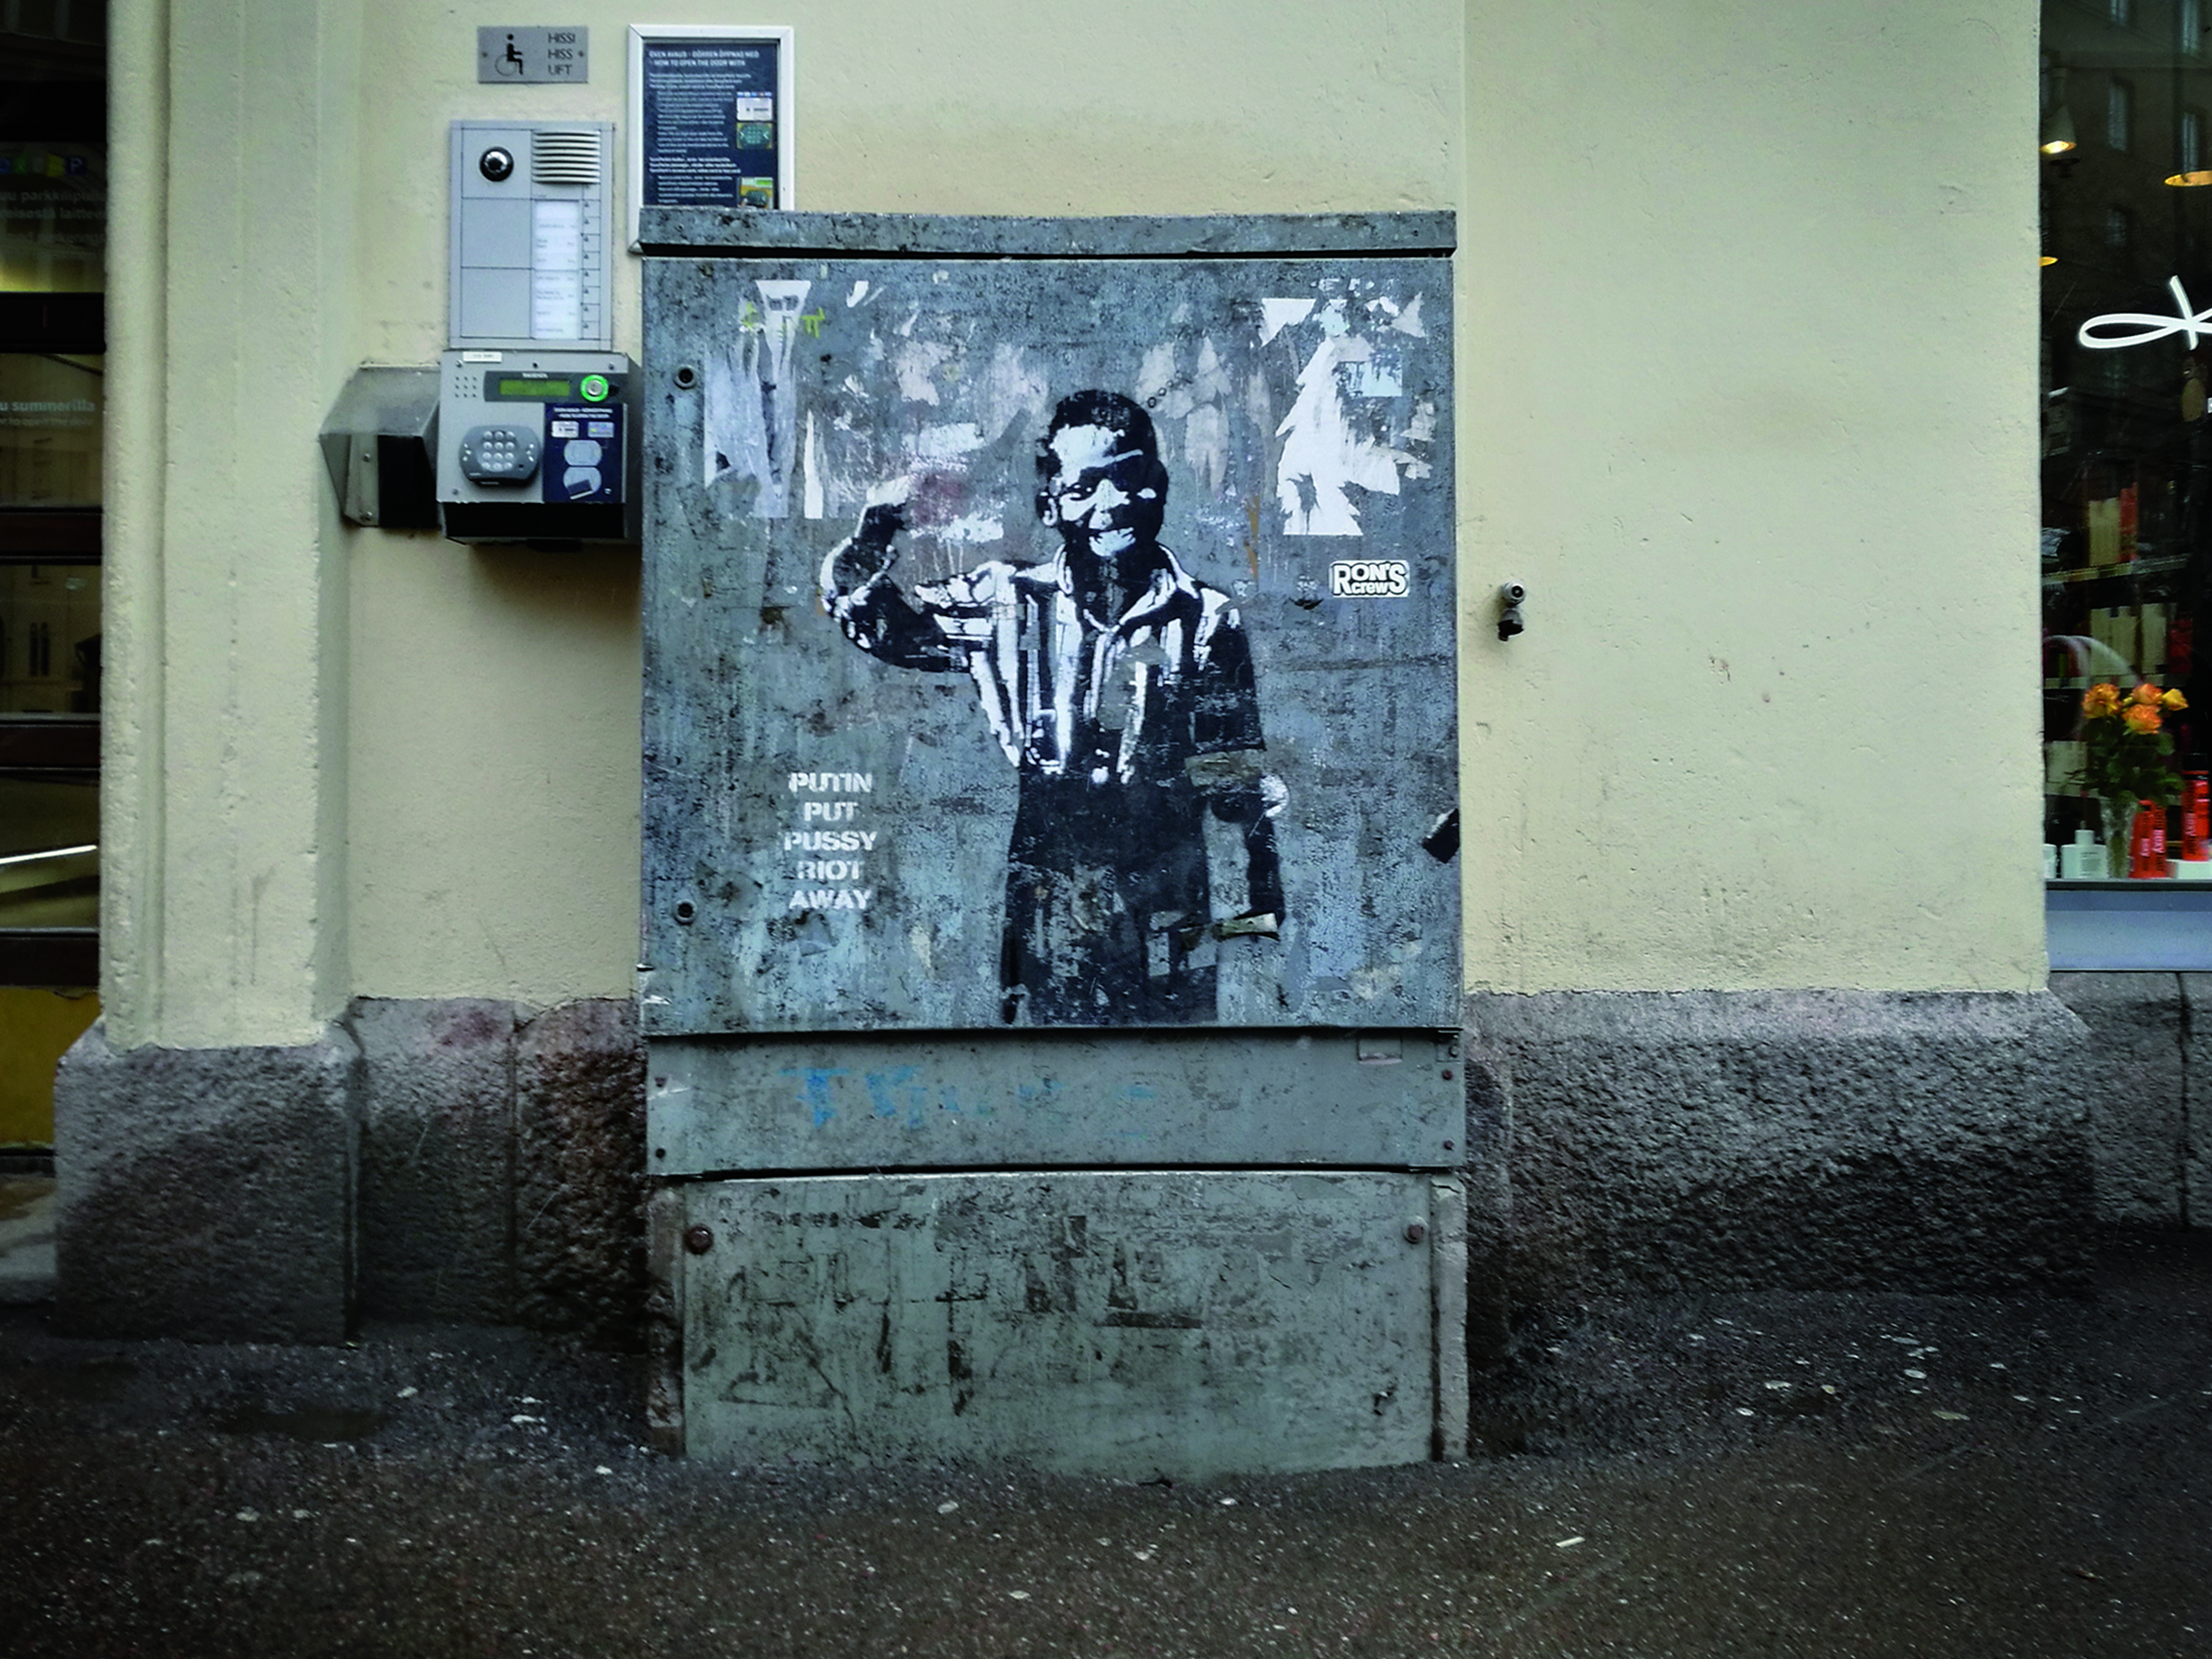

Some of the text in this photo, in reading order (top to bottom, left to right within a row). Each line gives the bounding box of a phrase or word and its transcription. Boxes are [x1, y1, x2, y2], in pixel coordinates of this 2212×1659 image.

[547, 32, 576, 45] HISSI
[547, 48, 573, 60] HISS
[547, 65, 572, 76] LIFT
[789, 772, 873, 793] PUTIN
[804, 801, 859, 822] PUT
[784, 830, 878, 851] PUSSY
[797, 859, 866, 880] RIOT
[789, 889, 872, 909] AWAY
